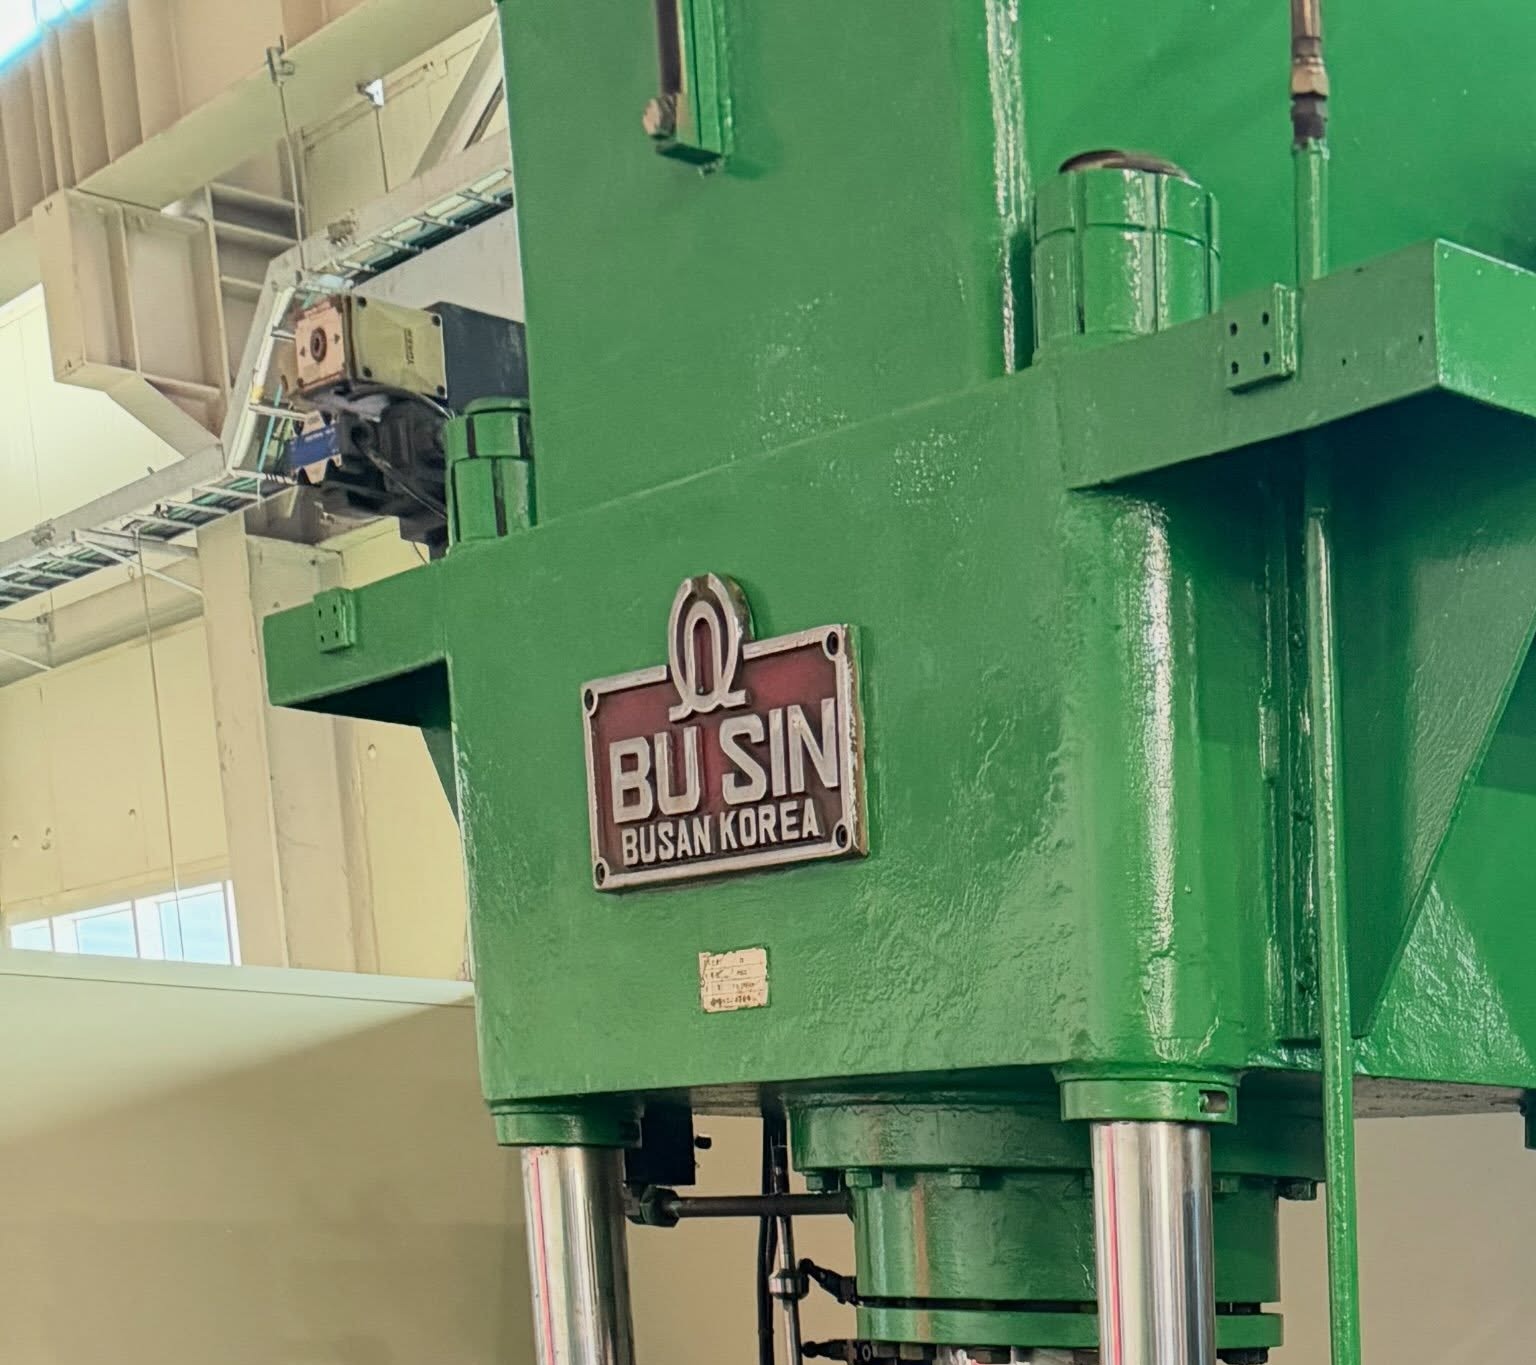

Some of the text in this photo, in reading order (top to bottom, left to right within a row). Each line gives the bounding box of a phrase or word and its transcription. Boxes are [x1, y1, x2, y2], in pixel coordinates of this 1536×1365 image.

[609, 698, 841, 823] BU SIN
[621, 797, 821, 867] BUSAN KOREA
